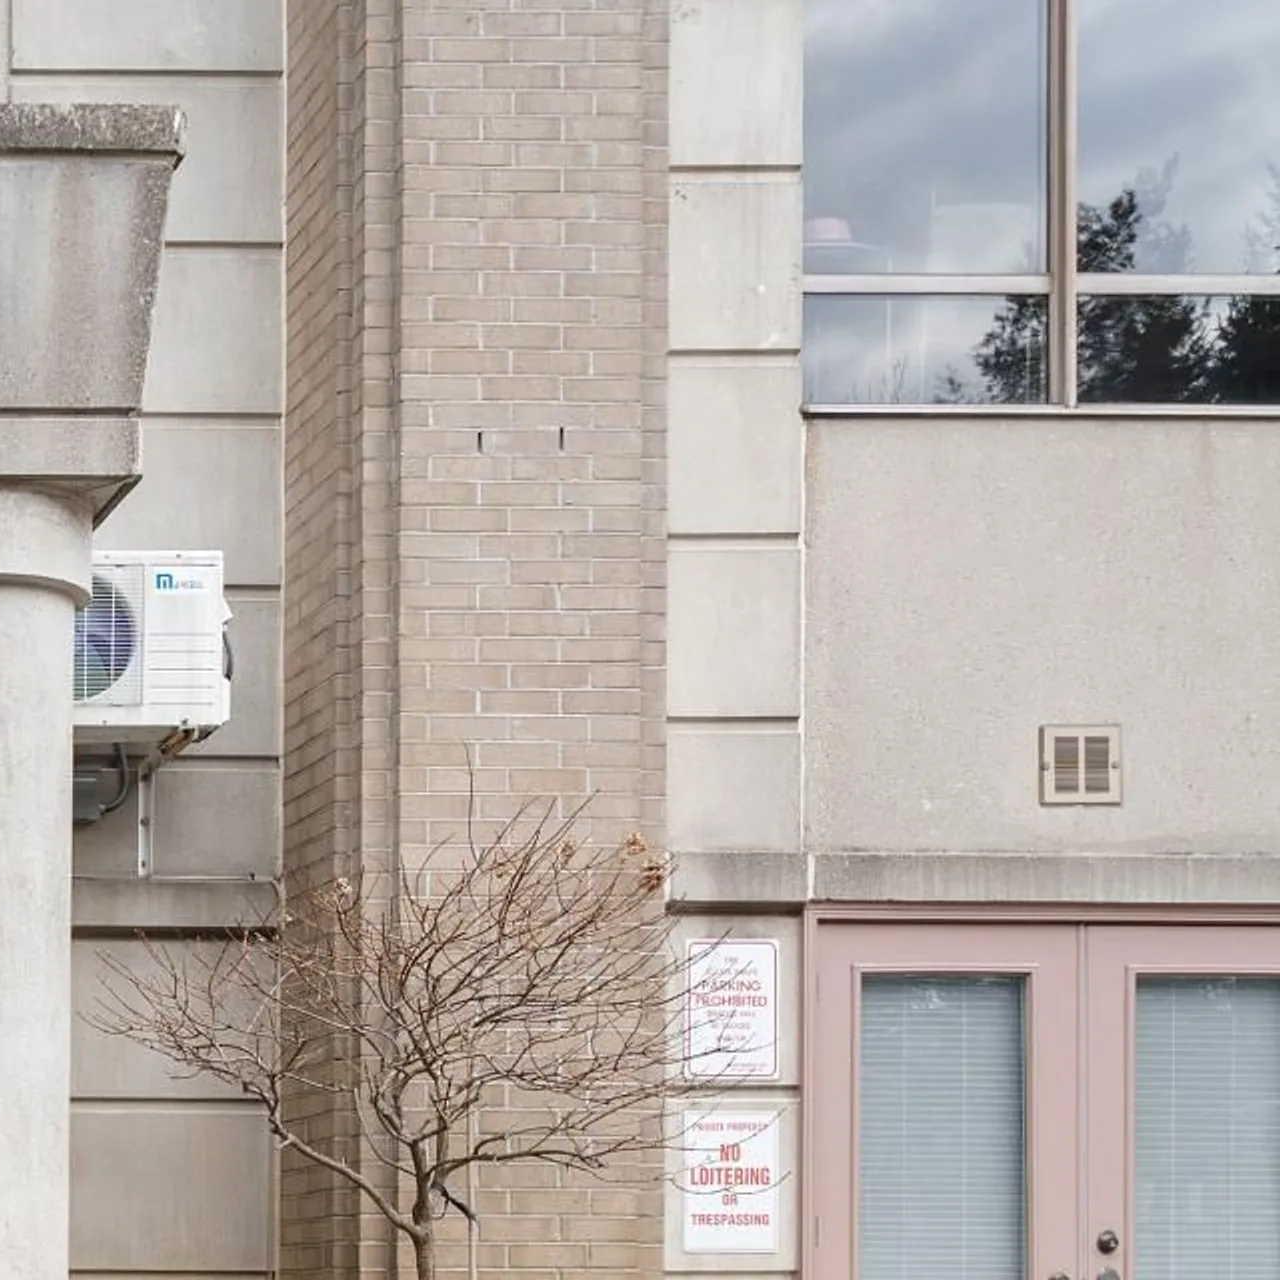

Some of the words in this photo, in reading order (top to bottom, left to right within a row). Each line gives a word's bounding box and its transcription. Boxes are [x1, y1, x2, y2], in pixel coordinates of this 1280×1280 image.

[696, 995, 768, 1008] PROHIBITED
[720, 1143, 741, 1162] NO
[691, 1167, 770, 1186] LOITERING
[722, 1194, 738, 1206] OR
[691, 1213, 770, 1226] TRESPASSING
